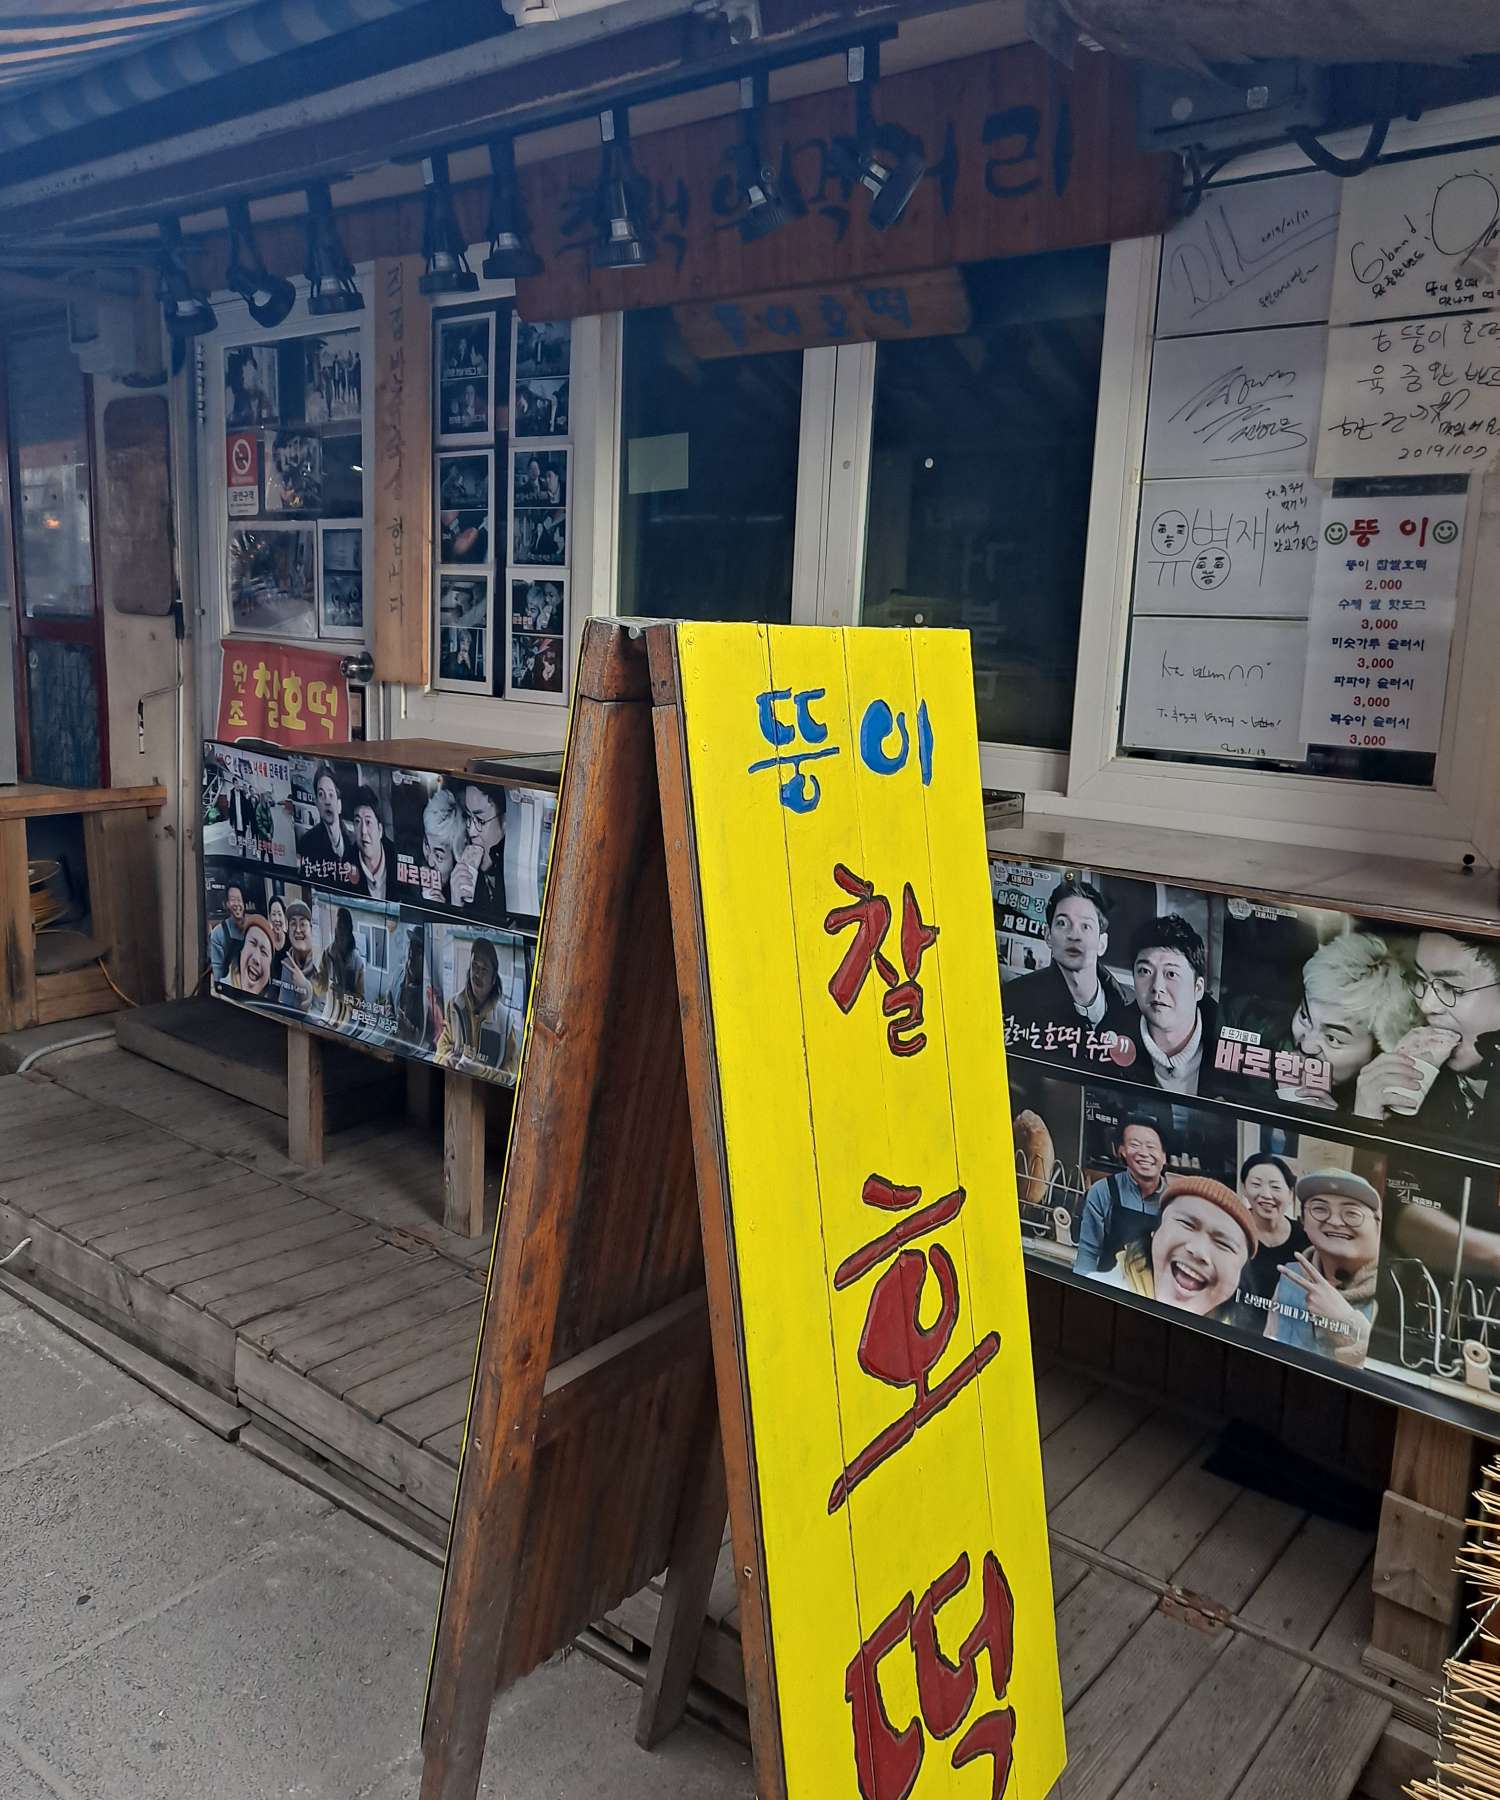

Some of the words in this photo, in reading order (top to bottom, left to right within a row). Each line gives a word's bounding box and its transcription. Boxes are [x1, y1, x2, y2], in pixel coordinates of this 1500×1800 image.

[1361, 619, 1398, 631] 3,000
[1331, 637, 1381, 650] 미숫가루
[1387, 638, 1425, 651] 슬러시
[1357, 657, 1394, 670] 3,000
[1333, 675, 1370, 688] 파파야
[1377, 677, 1414, 690] 슬러시
[252, 660, 338, 740] 찰호떡
[1353, 696, 1390, 708] 3,000
[1330, 713, 1366, 727] 복숭아
[1373, 716, 1410, 729] 슬러시
[1349, 734, 1386, 746] 3,000
[747, 686, 933, 814] 뚱이
[396, 862, 420, 885] 바로
[1043, 1021, 1081, 1059] 호떡
[1214, 1039, 1271, 1079] 바로
[1274, 1050, 1331, 1091] 한입
